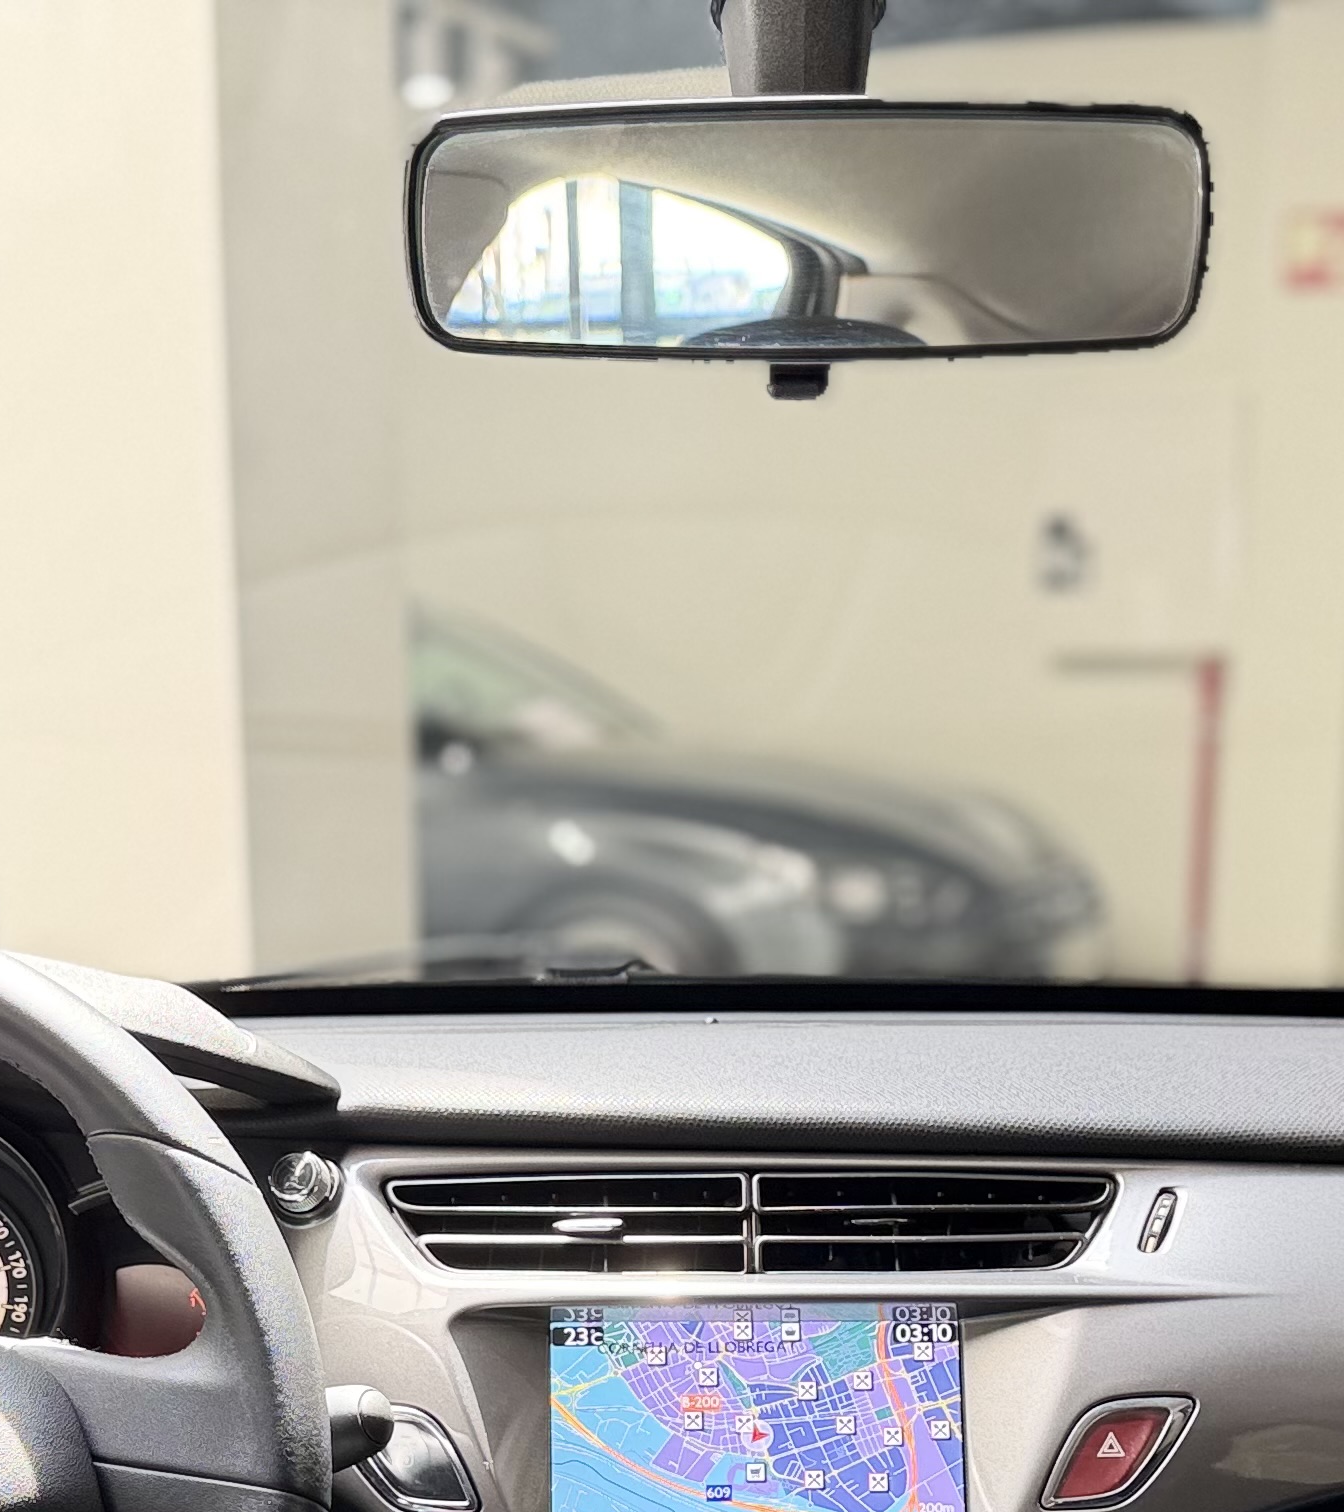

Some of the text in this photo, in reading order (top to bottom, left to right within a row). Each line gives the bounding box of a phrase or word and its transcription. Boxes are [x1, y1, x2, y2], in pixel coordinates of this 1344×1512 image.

[8, 1250, 29, 1279] 170
[11, 1295, 29, 1323] 190
[894, 1323, 954, 1343] 03:10
[684, 1341, 705, 1354] DE
[681, 1396, 721, 1409] B-200
[706, 1486, 732, 1499] 609
